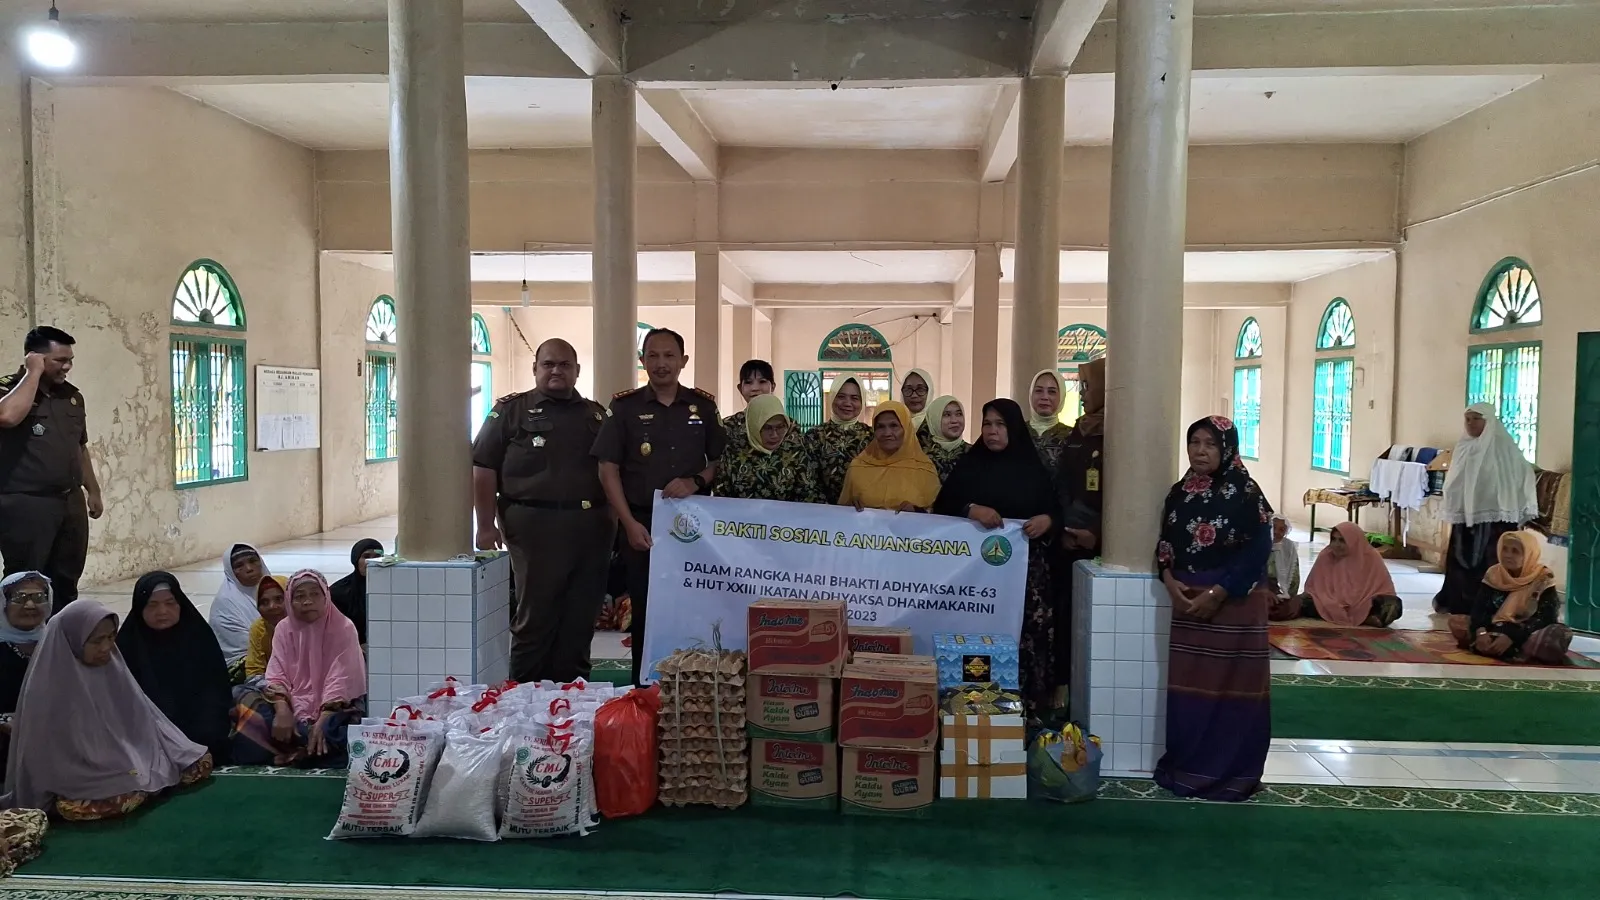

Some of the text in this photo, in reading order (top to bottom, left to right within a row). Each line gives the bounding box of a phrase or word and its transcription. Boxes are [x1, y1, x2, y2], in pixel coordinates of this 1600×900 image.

[713, 520, 971, 556] BAKTI SOSIAL & ANJANGSANA
[684, 562, 997, 598] DALAM RANGKA HARI BHAKTI ADHYAKSA KE-63
[683, 578, 995, 614] & HUT XXIII IKATAN ADHYAKSA DHARMAKARINI
[847, 610, 877, 622] 2023
[763, 706, 790, 714] Kaldu
[764, 714, 790, 722] Ayam
[374, 758, 400, 768] CML
[536, 763, 562, 772] CML
[763, 770, 789, 779] Kaldu
[763, 779, 789, 788] Ayam
[855, 781, 882, 789] Kaldu
[366, 791, 395, 800] SUPER
[854, 790, 882, 798] Ayam
[528, 796, 558, 805] SUPER
[341, 822, 365, 832] MUTU
[367, 824, 404, 833] TERBAIK
[509, 824, 532, 834] MUTU
[534, 824, 569, 834] TERBAIK
